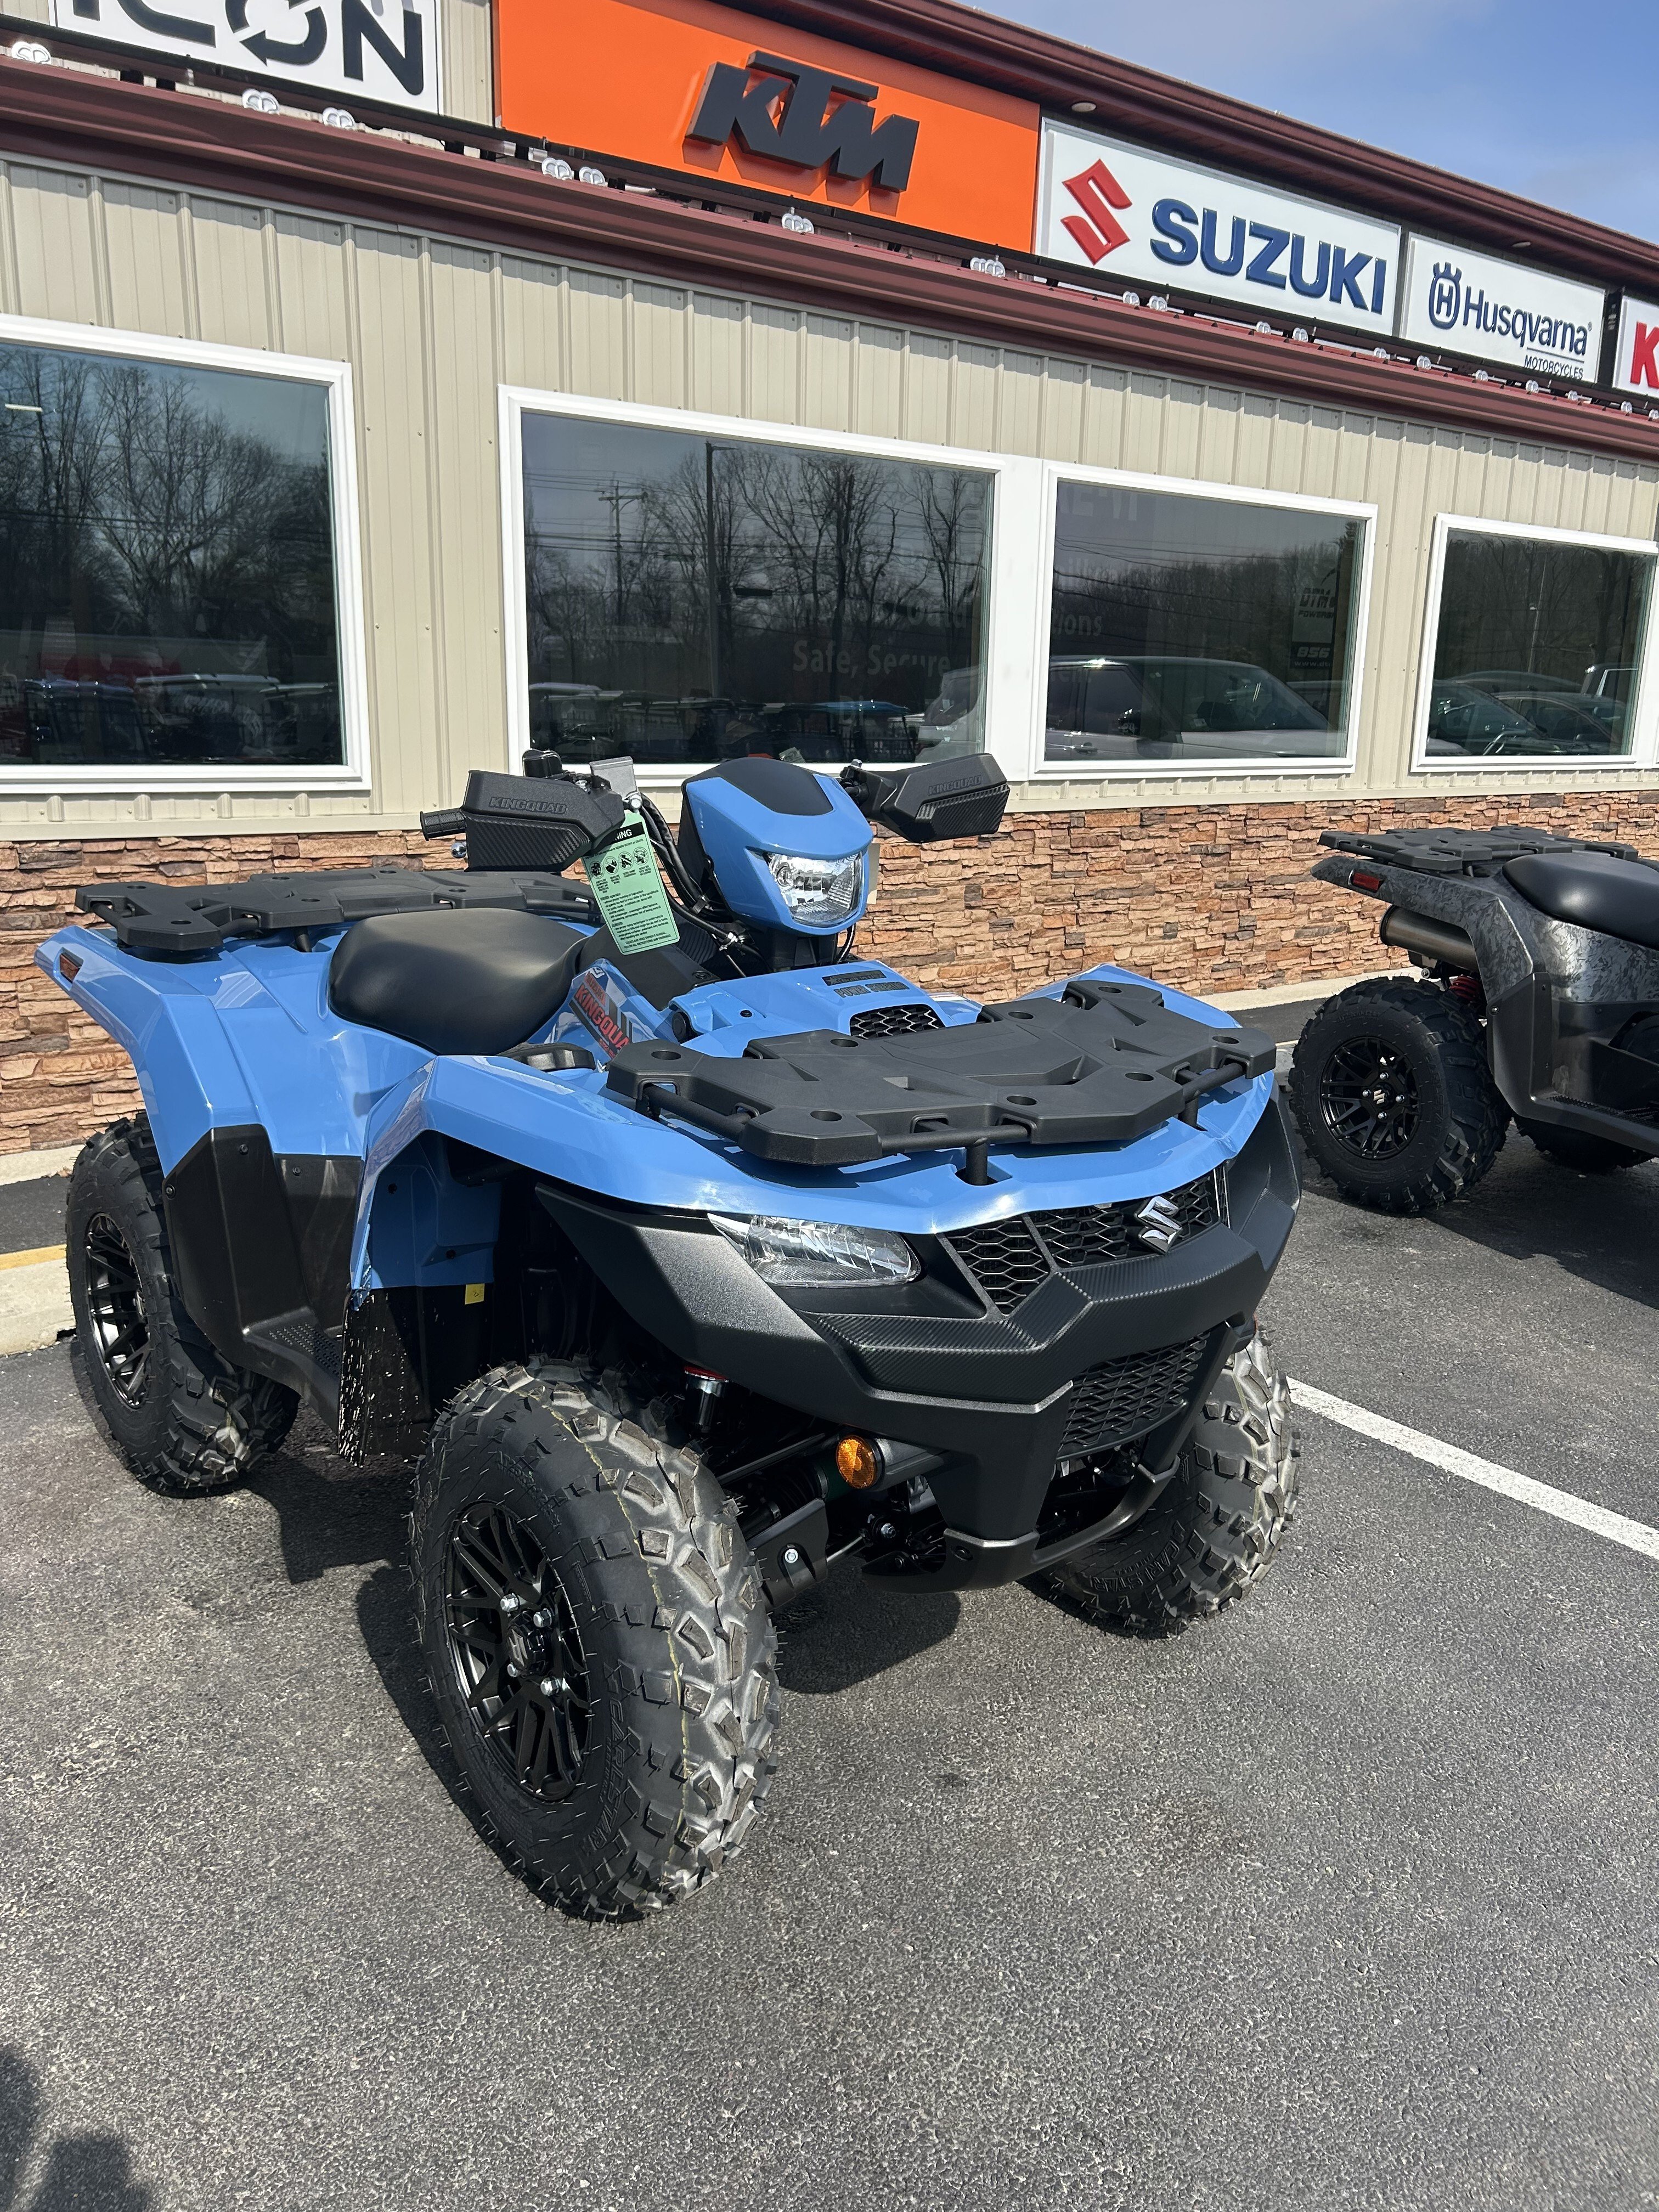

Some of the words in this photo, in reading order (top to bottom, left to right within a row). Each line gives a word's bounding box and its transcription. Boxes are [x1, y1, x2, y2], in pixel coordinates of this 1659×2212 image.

[685, 49, 919, 194] KTM
[1150, 198, 1387, 315] SUZUKI
[1463, 285, 1587, 356] Husqvarna
[1524, 354, 1584, 381] MOTORCYCLES
[793, 640, 859, 679] Safe,
[1297, 647, 1330, 658] 856
[928, 775, 983, 795] KINGQUAD
[489, 797, 567, 815] KINGQUAD
[833, 985, 871, 998] POWER
[865, 981, 910, 992] STEERING
[574, 984, 629, 1050] KINGQUA
[588, 1697, 624, 1851] CARLSTAR
